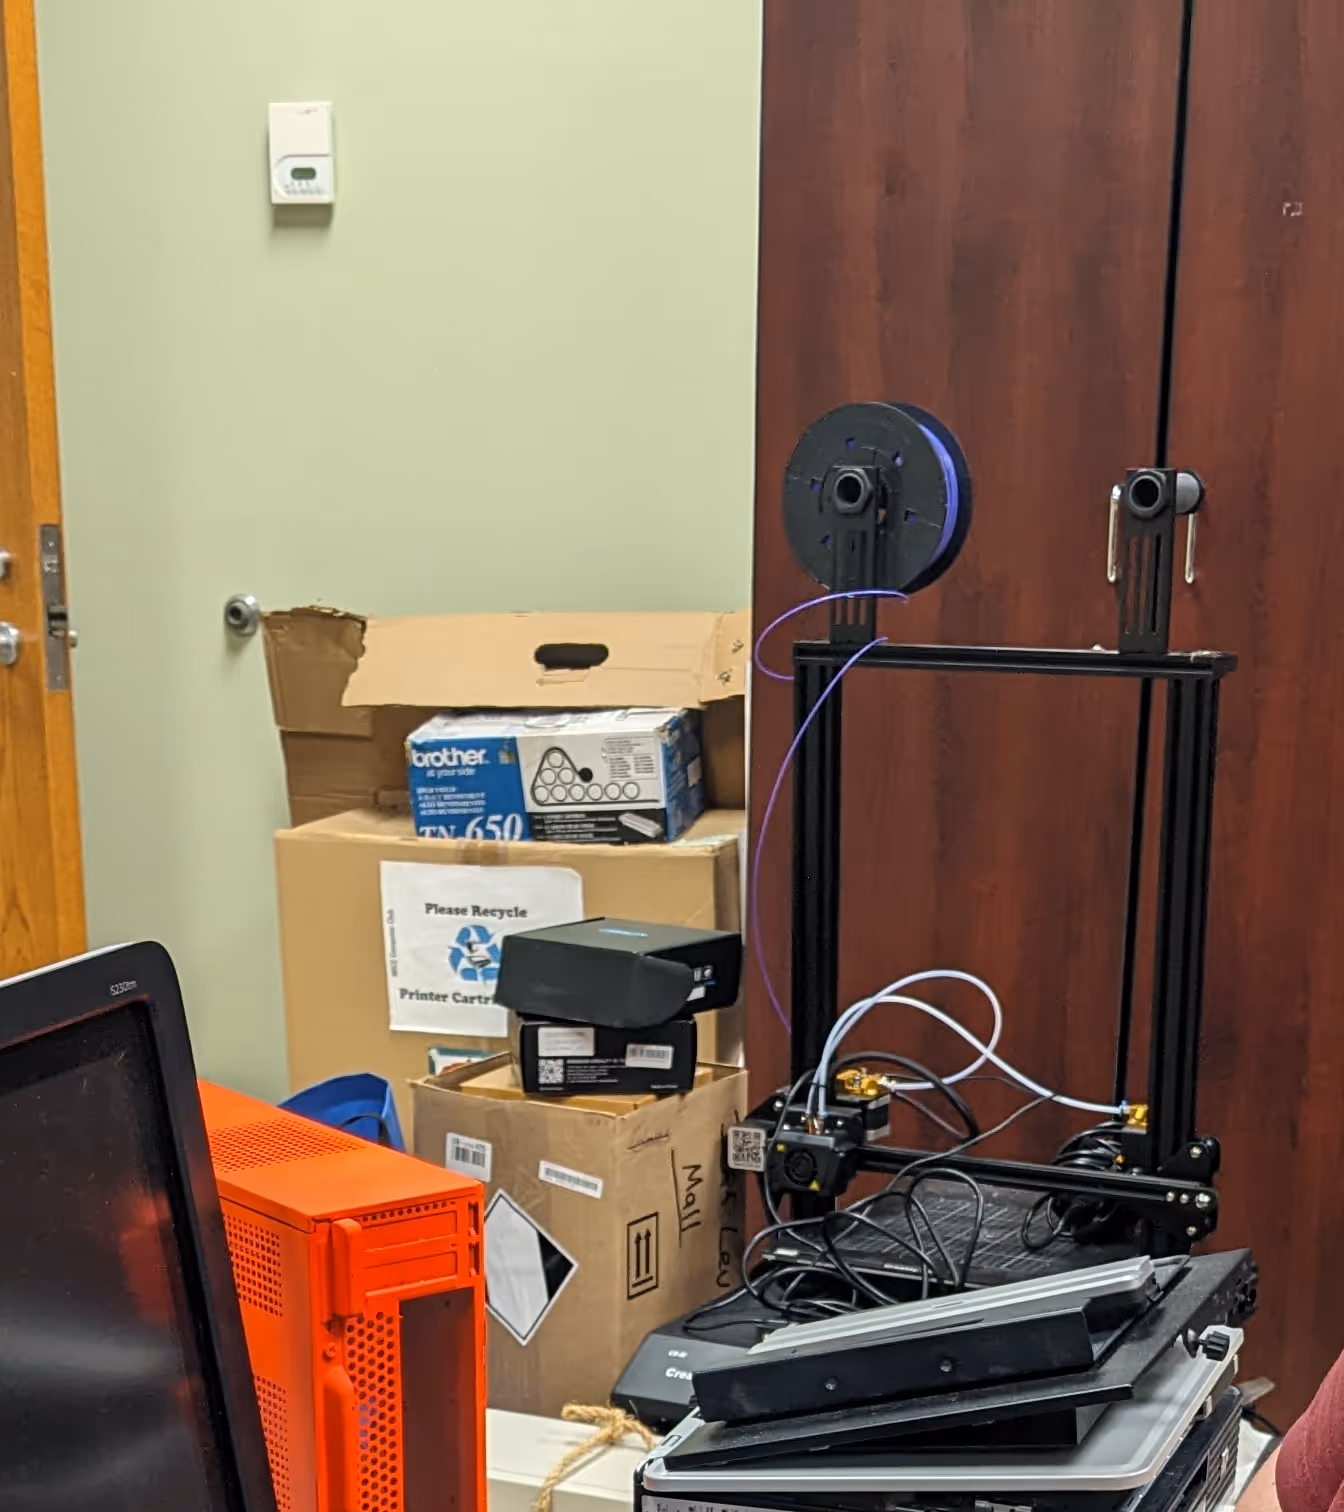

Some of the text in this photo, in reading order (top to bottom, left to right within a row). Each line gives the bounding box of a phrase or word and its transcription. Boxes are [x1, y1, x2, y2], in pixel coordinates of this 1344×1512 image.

[411, 747, 487, 768] brother
[425, 902, 528, 920] Please Recycle
[399, 987, 497, 1005] Printer Cartri
[681, 1163, 704, 1233] Mall
[665, 1367, 693, 1381] Crea
